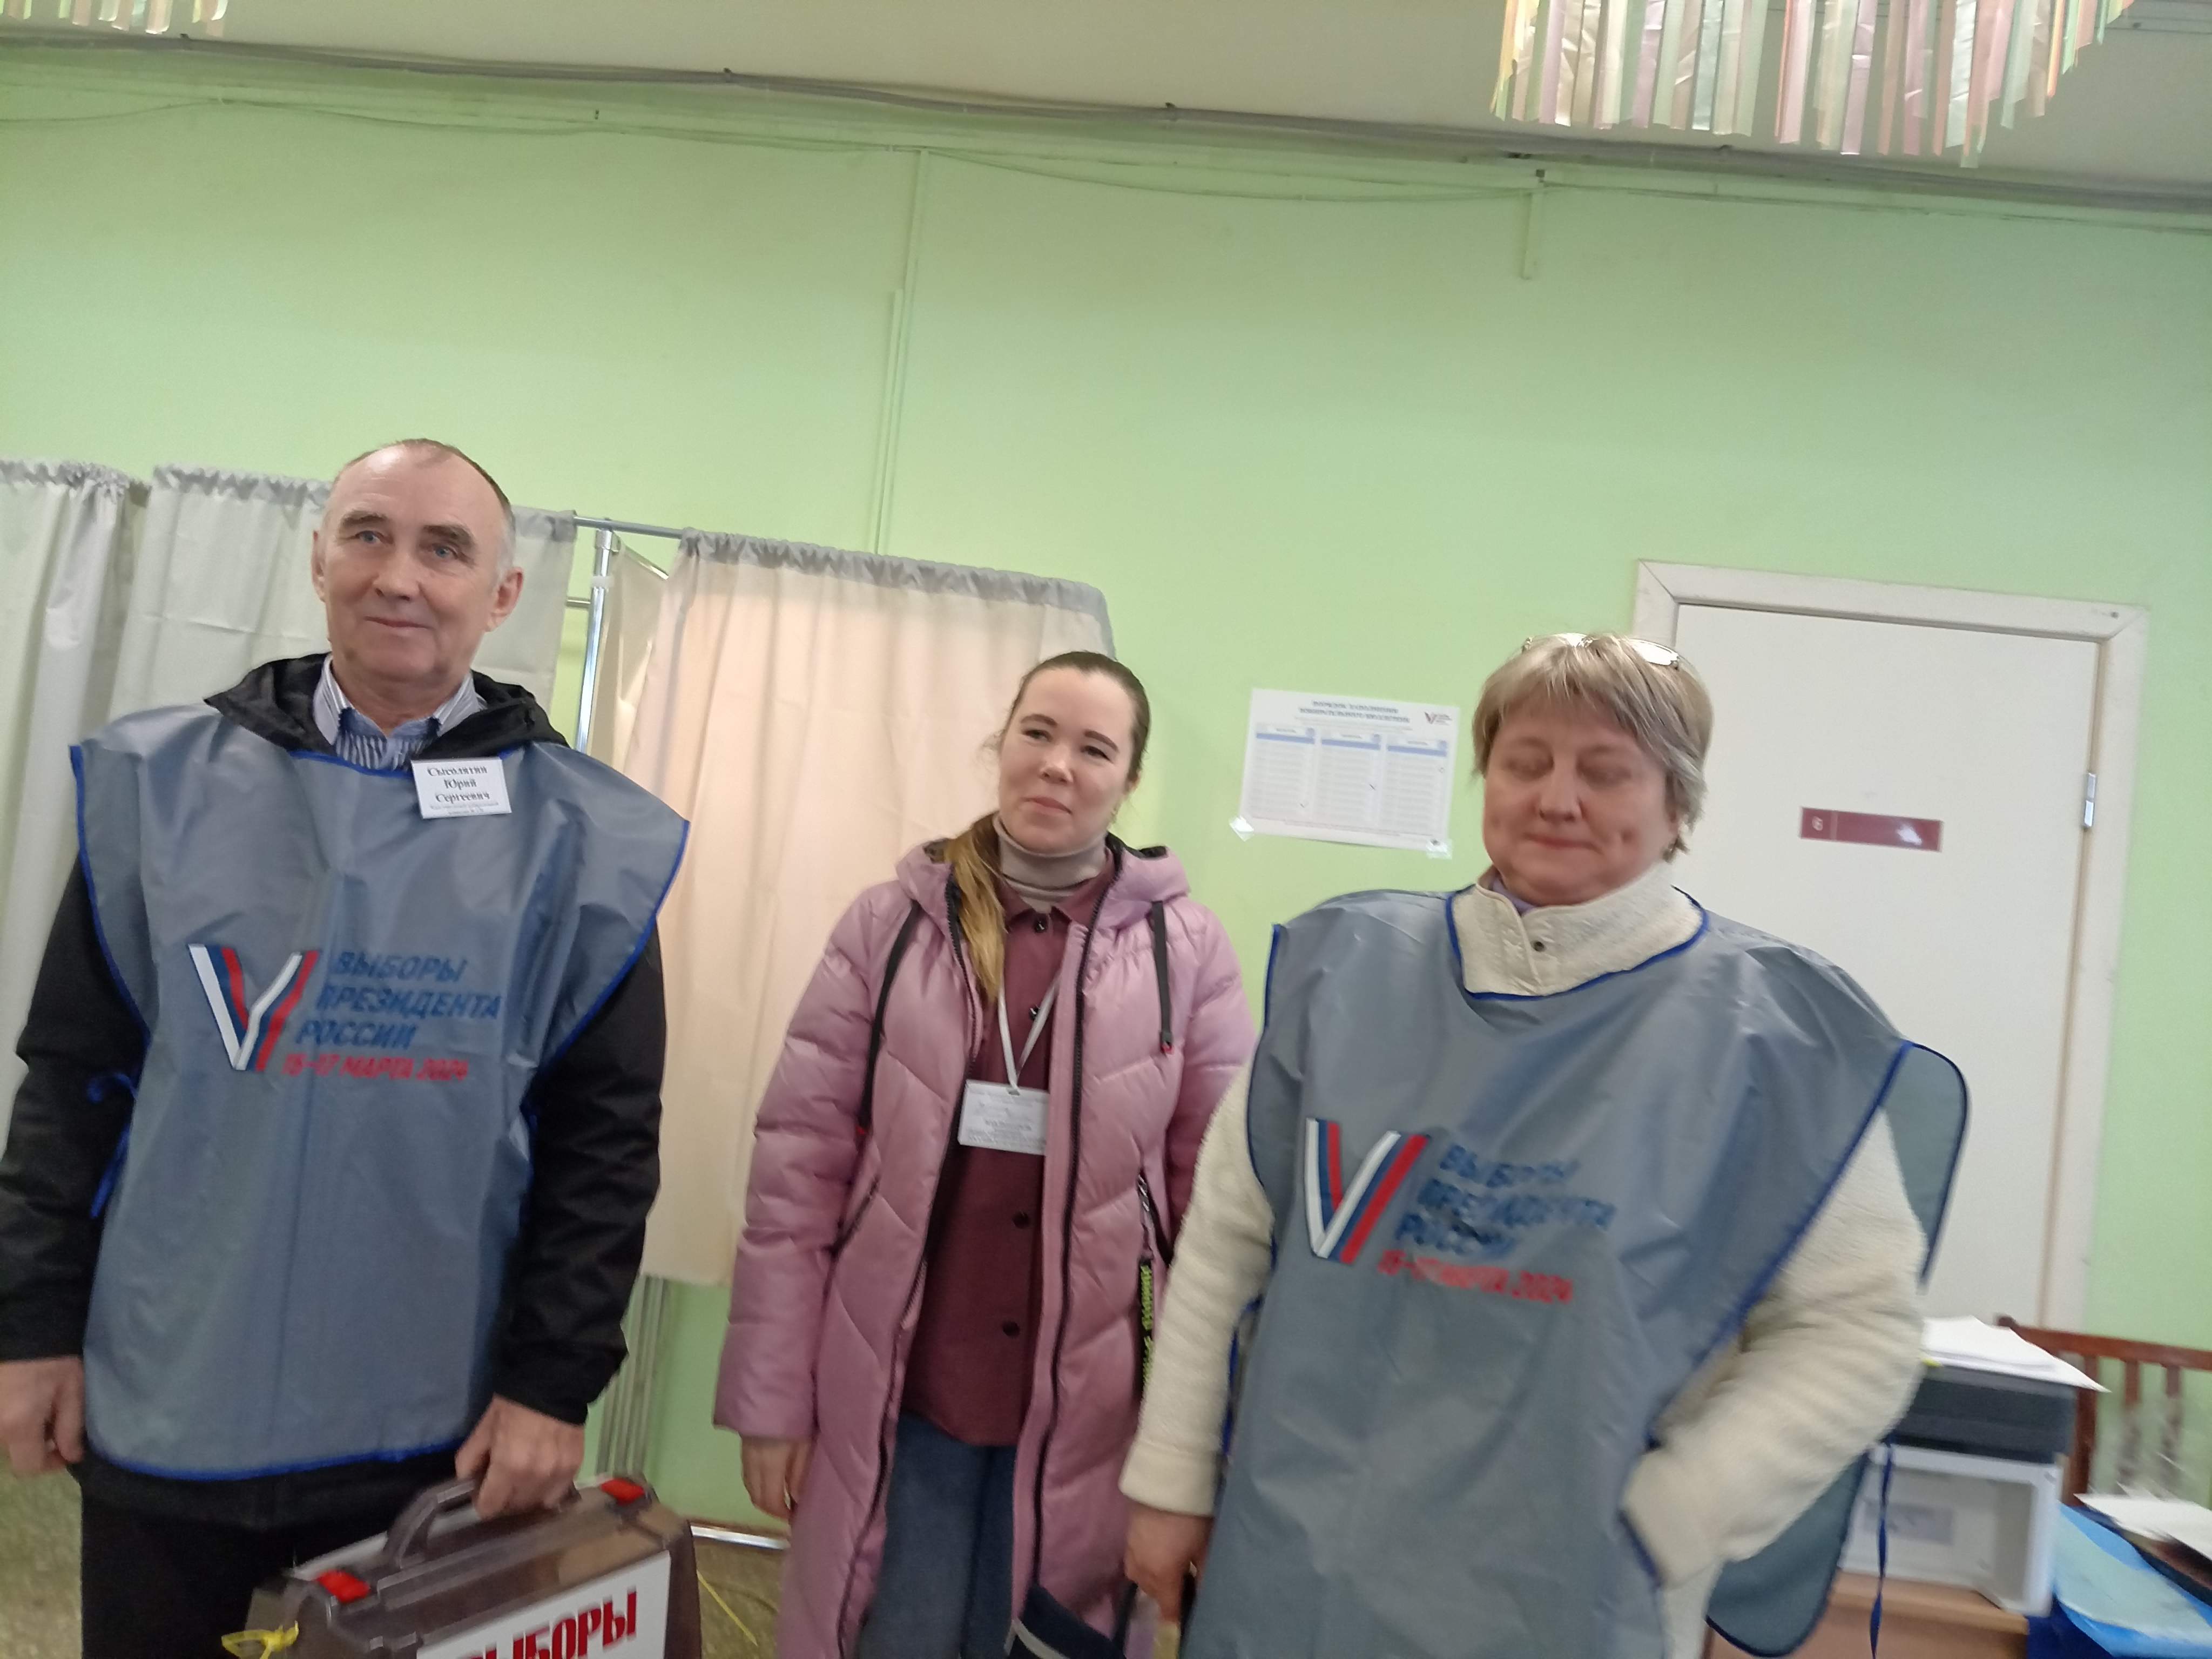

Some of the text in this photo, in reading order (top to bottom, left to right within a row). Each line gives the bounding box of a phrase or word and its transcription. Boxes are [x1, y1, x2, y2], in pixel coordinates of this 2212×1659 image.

[435, 792, 490, 804] Сергеевич
[443, 778, 477, 791] Юрий
[331, 952, 468, 982] ВЫБОРЫ
[316, 984, 503, 1020] ПРЕЗИДЕНТА
[295, 1019, 419, 1050] РОССИИ
